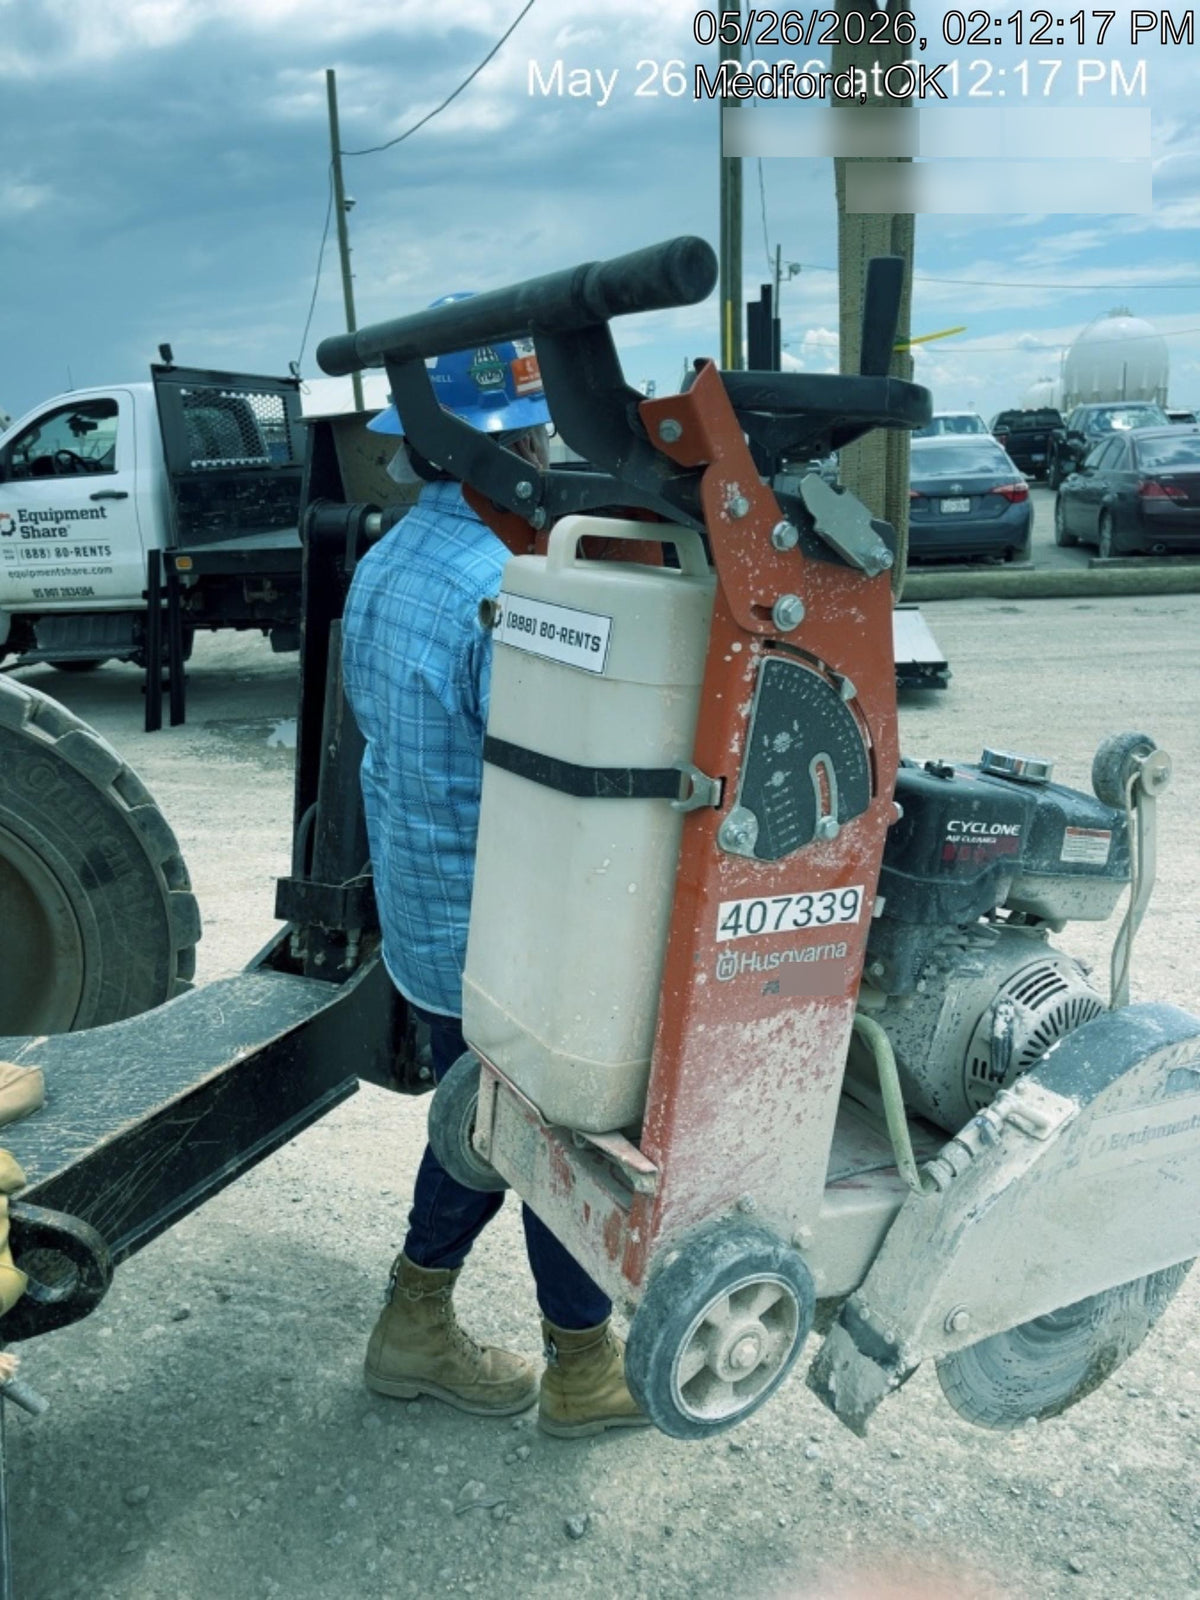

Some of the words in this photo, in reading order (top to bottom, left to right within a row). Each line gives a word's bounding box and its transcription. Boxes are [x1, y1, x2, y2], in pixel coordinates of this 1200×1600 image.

[17, 506, 107, 525] Equipment
[20, 525, 68, 539] Share
[20, 547, 50, 560] (888)
[55, 545, 112, 558] 80-RENTS
[8, 566, 113, 579] equipmentshare.com
[507, 611, 537, 636] (888)
[540, 621, 602, 653] 80-RENTS
[946, 820, 1021, 837] CYCLONE
[720, 889, 859, 936] 407339
